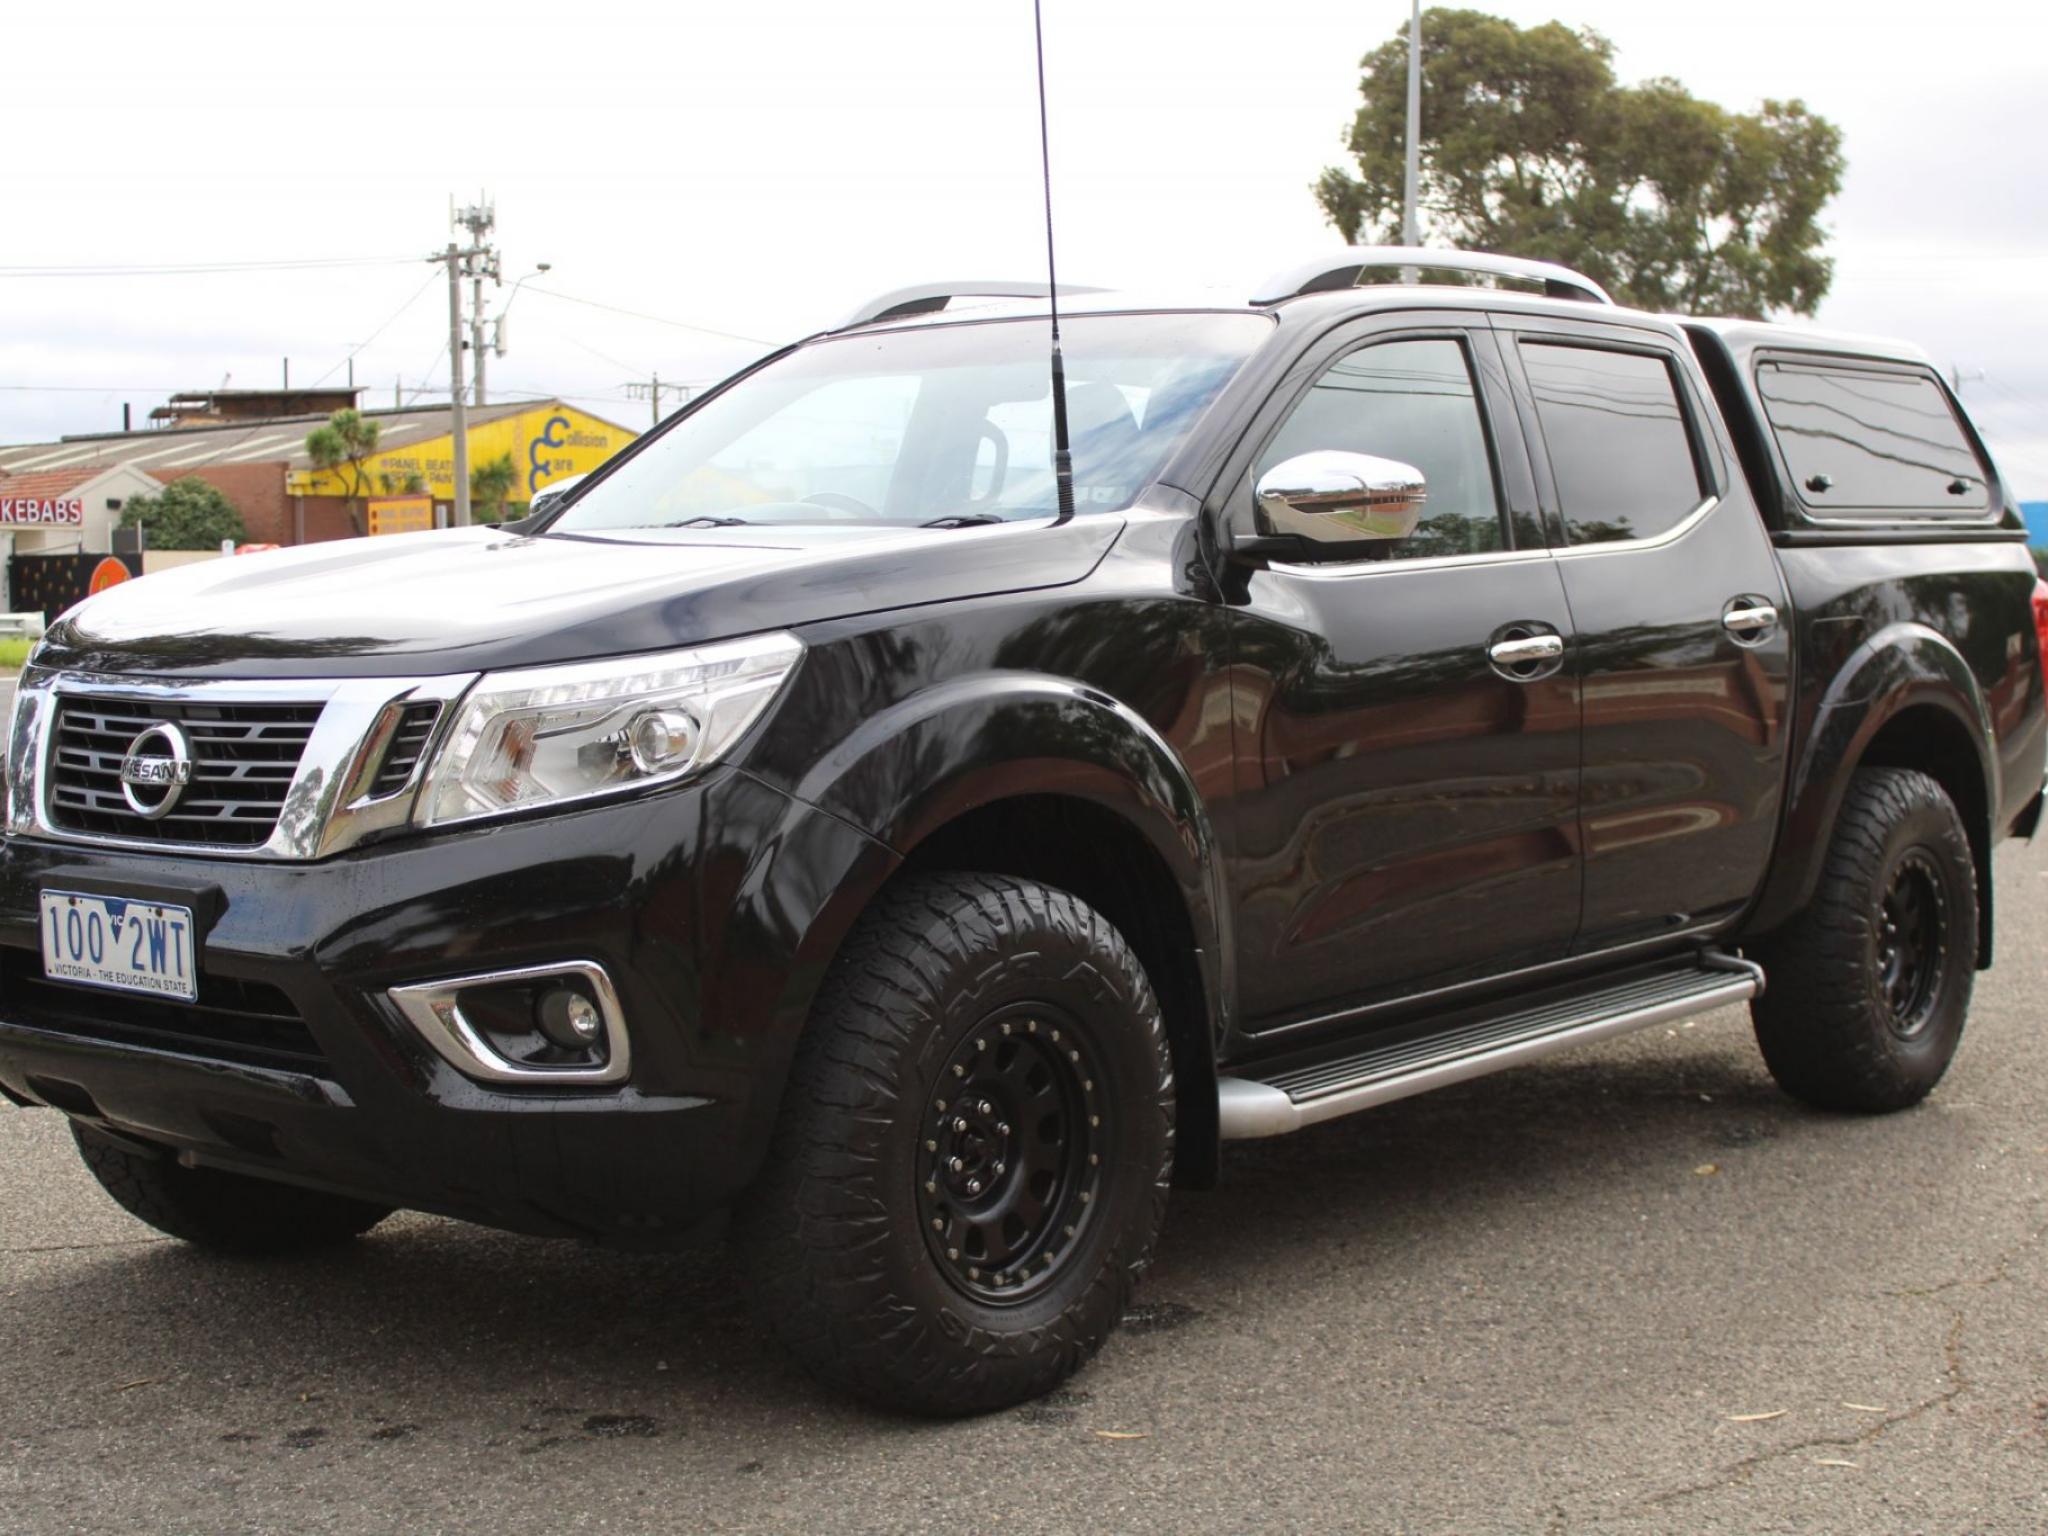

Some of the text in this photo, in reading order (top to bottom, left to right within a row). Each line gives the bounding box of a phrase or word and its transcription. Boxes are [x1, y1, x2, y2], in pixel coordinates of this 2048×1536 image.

[544, 416, 608, 448] Collision
[390, 458, 420, 470] PANEL
[1, 499, 81, 522] KEBABS
[121, 757, 177, 779] NISSAN
[50, 906, 184, 977] 100 2WT
[54, 963, 92, 978] VICTORIA
[98, 969, 115, 982] THE
[116, 973, 162, 990] EDUCATION
[163, 981, 188, 994] STATE
